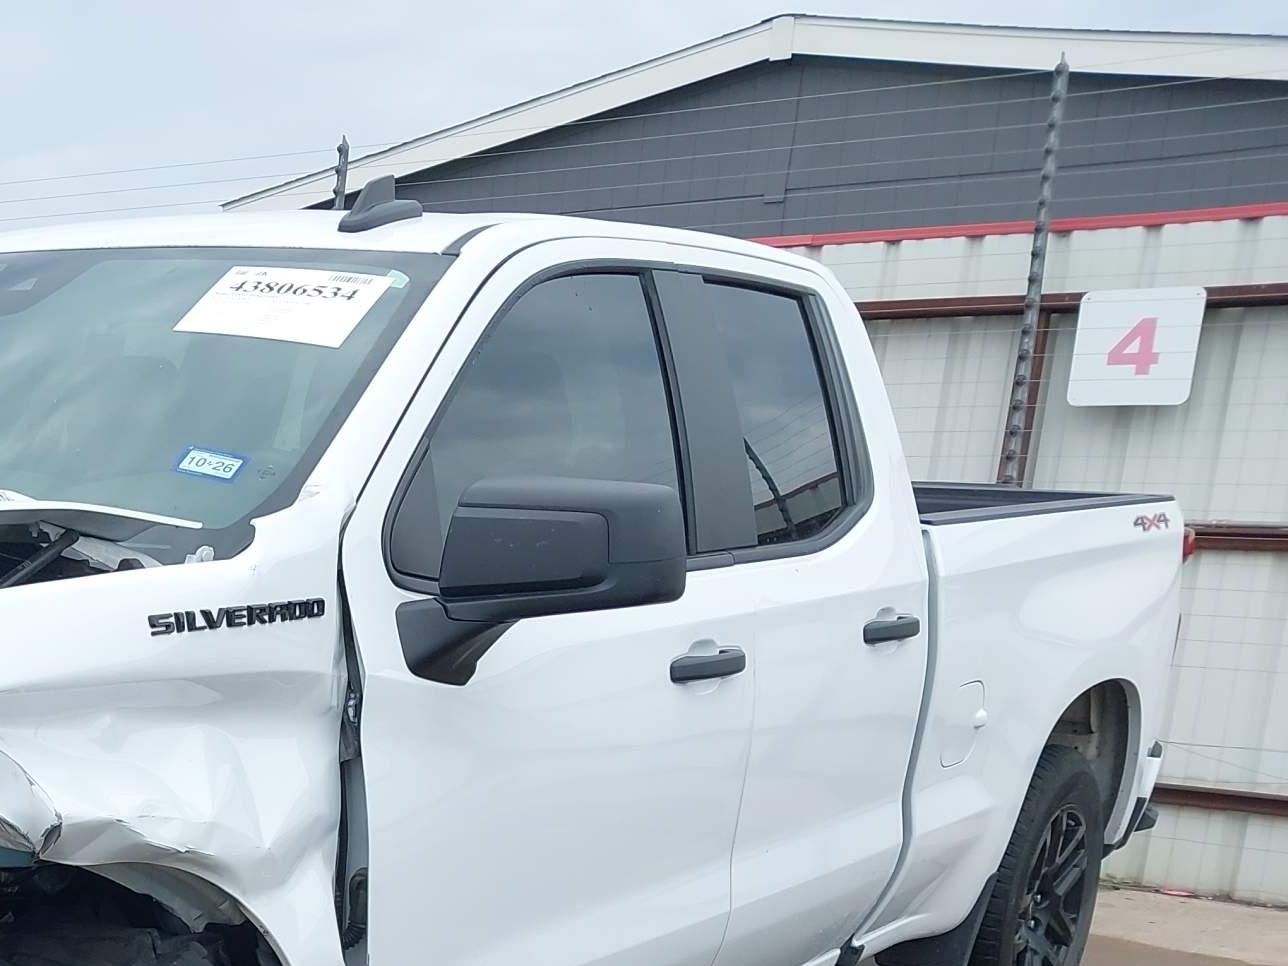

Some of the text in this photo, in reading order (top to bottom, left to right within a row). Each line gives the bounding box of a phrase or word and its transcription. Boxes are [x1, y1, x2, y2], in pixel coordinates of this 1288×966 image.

[229, 280, 360, 301] 43806534
[1106, 317, 1160, 376] 4
[147, 597, 326, 636] SILVERADO
